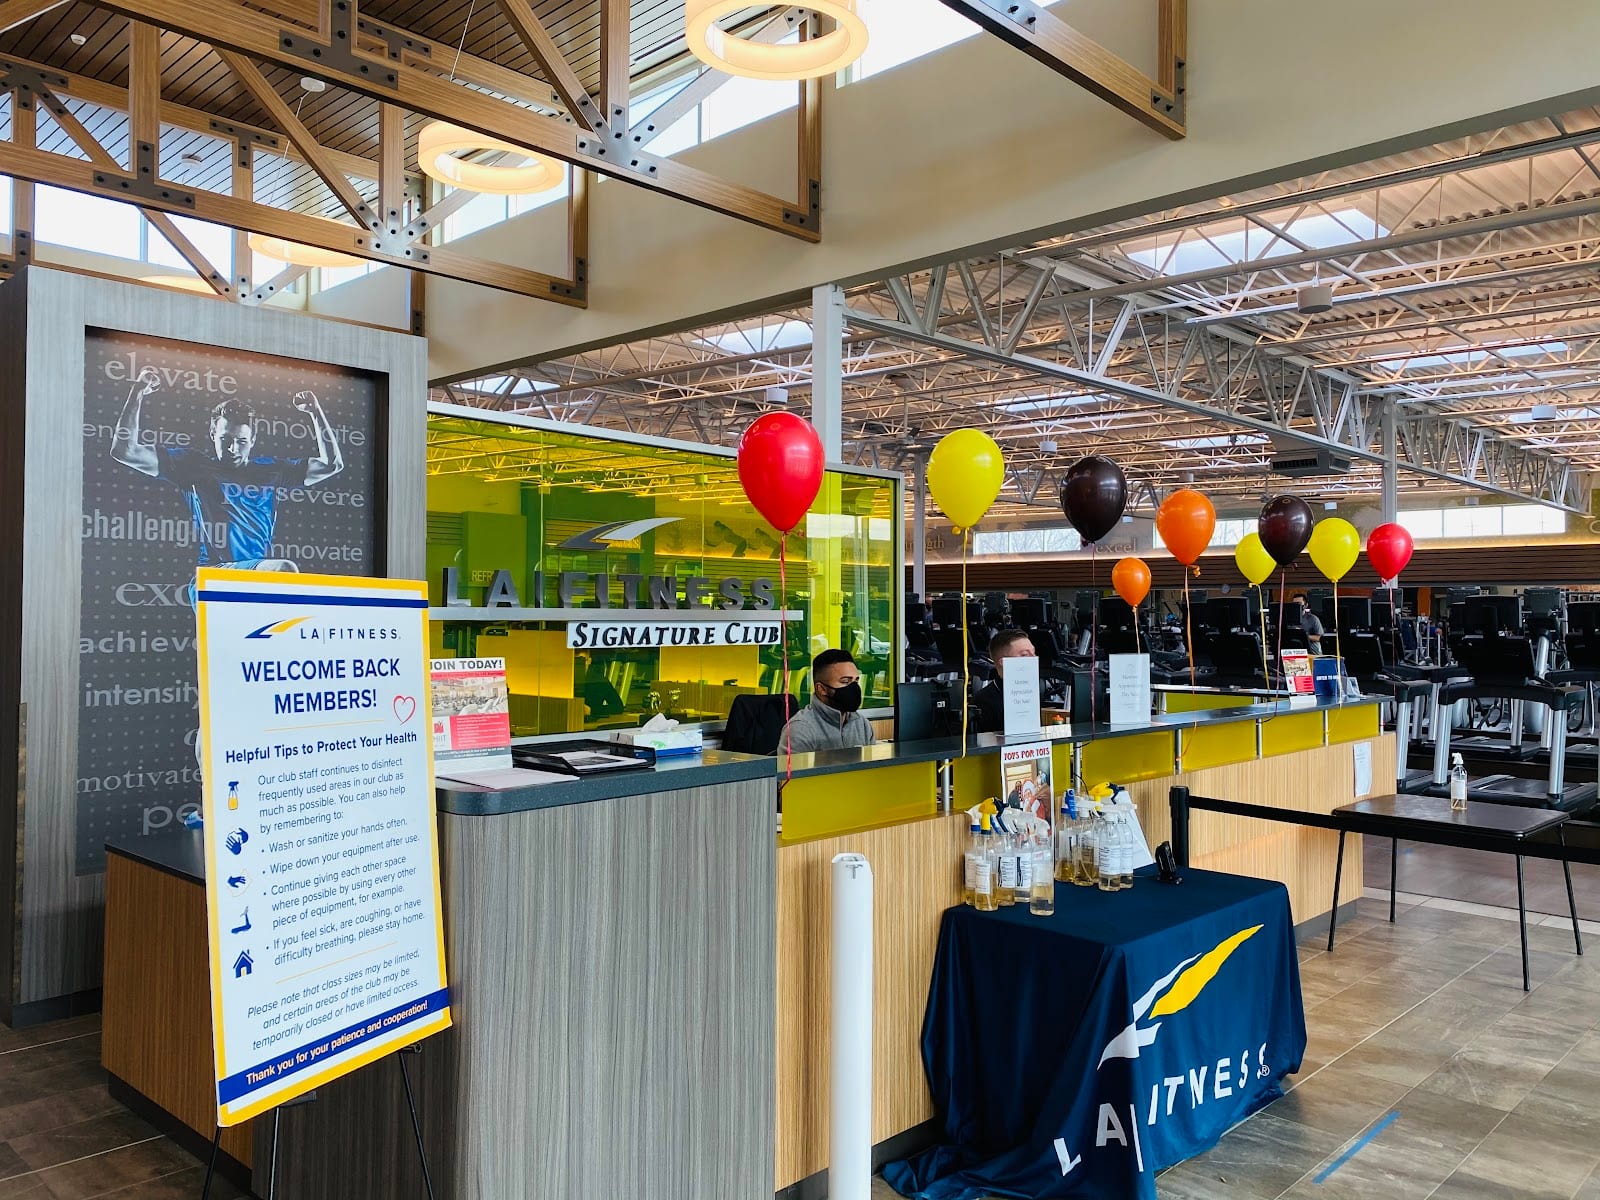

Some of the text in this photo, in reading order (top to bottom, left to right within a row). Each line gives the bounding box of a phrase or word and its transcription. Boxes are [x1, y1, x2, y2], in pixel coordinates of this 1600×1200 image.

[104, 352, 238, 394] elevate
[82, 422, 191, 446] enegize
[249, 415, 366, 446] innovate
[220, 482, 365, 507] persevere
[80, 508, 227, 549] challenging
[264, 543, 363, 562] innovate
[1095, 537, 1136, 554] excel
[572, 621, 780, 648] SIGNATURE CLUB
[240, 658, 400, 682] WELCOME BACK
[460, 659, 502, 670] TODAY!
[274, 688, 376, 714] MEMBERS!
[225, 731, 416, 764] Helpful Tips to Protect Your Health
[257, 758, 402, 785] Our club staff continues to disinfect
[258, 772, 403, 801] frequently used areas in our club as
[259, 804, 284, 817] much
[287, 804, 297, 812] as
[338, 794, 353, 803] You
[356, 792, 370, 800] can
[372, 788, 387, 798] also
[389, 785, 405, 795] help
[260, 811, 343, 835] by remembering to:
[268, 840, 293, 852] Wash
[296, 838, 305, 847] or
[307, 831, 338, 845] sanitize
[341, 828, 358, 840] your
[361, 822, 384, 833] hands
[269, 862, 293, 874] Wipe
[295, 856, 319, 868] down
[321, 851, 340, 864] your
[342, 841, 384, 858] equipment
[385, 838, 402, 848] after
[271, 856, 406, 895] Continue giving each other space
[271, 867, 416, 911] where possible by using every other
[272, 914, 296, 930] piece
[299, 908, 308, 920] of
[358, 894, 369, 903] for
[273, 938, 279, 949] If
[282, 935, 298, 949] you
[301, 927, 317, 941] feel
[340, 919, 353, 929] are
[394, 904, 402, 912] or
[404, 899, 421, 909] have
[274, 947, 312, 965] difficulty
[358, 924, 383, 941] please
[386, 919, 400, 929] stay
[247, 1000, 278, 1018] Please
[281, 992, 300, 1005] note
[303, 984, 319, 998] that
[321, 977, 342, 990] class
[344, 970, 363, 982] sizes
[365, 963, 381, 975] may
[383, 959, 392, 968] be
[263, 968, 409, 1029] and certain areas of the club may be
[253, 1023, 303, 1050] temporarily
[305, 1009, 332, 1028] closed
[335, 1007, 343, 1017] or
[345, 999, 364, 1013] have
[366, 987, 391, 1004] limited
[246, 1000, 427, 1084] Thank you for your patience and cooperation!
